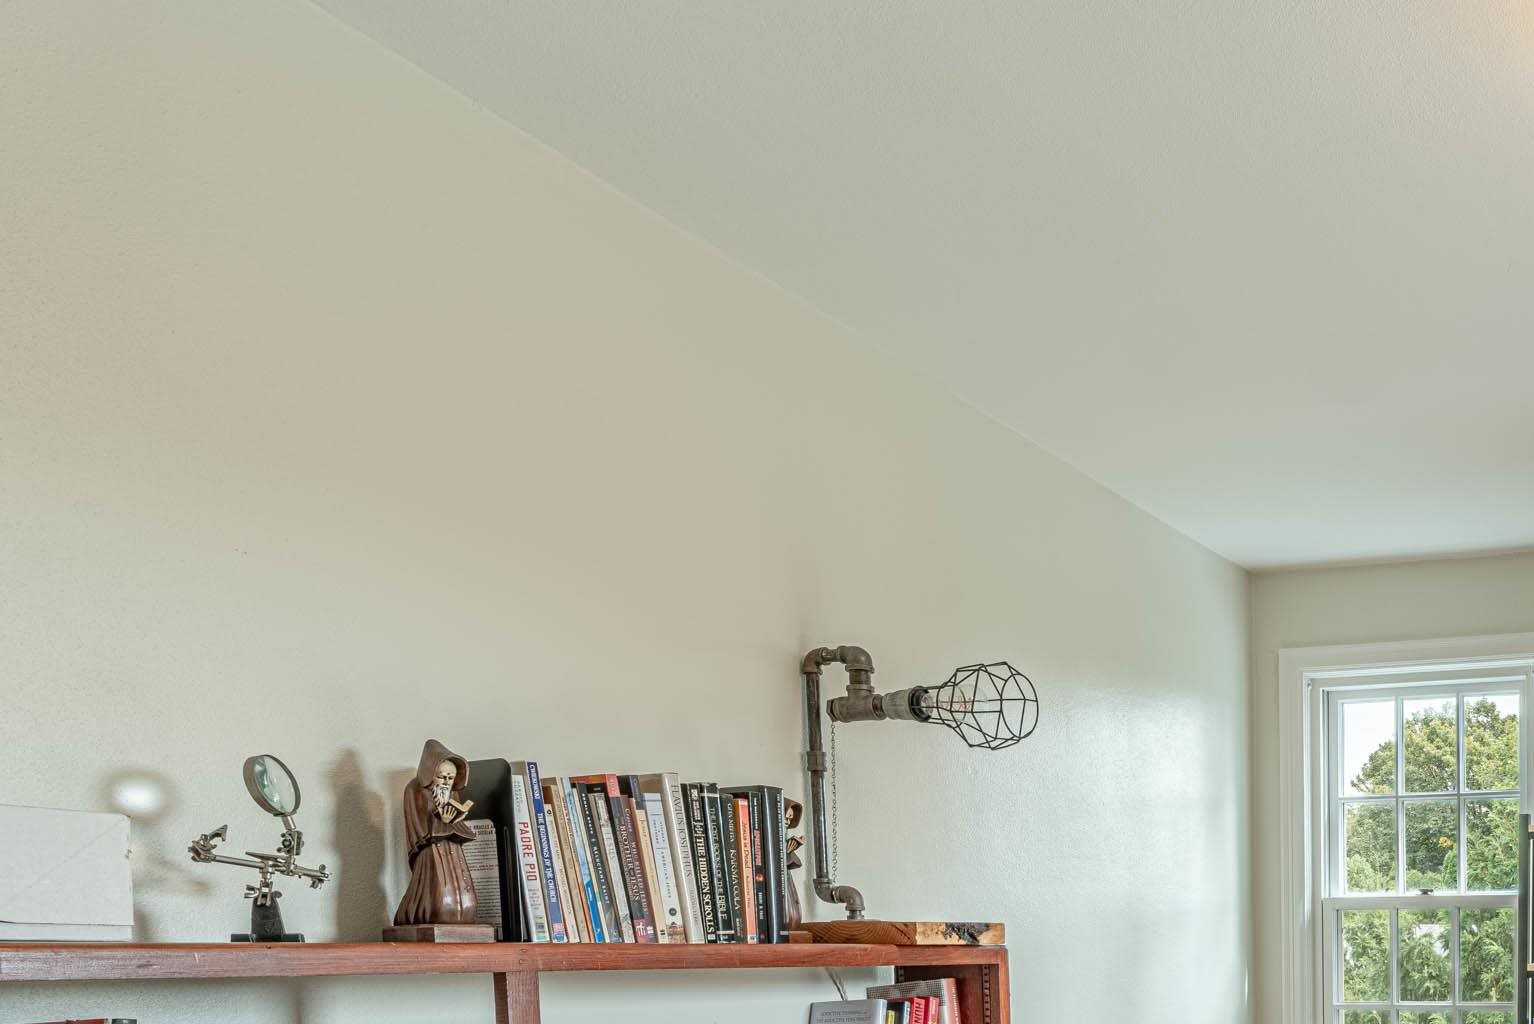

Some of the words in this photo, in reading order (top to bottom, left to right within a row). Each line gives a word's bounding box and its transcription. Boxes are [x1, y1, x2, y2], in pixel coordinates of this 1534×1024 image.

[536, 812, 545, 824] THE
[709, 808, 717, 821] THE
[518, 821, 534, 858] PADRE
[538, 824, 550, 858] BEGINNINGS
[671, 784, 685, 825] FLAVIUS
[678, 827, 692, 878] JOSEPHUS
[711, 822, 719, 841] LOST
[695, 837, 706, 856] THE
[712, 843, 722, 868] BOOKS
[524, 862, 538, 882] PIO
[543, 858, 552, 866] OF
[545, 868, 554, 878] THE
[619, 825, 634, 869] BROTHER
[629, 875, 640, 901] JESUS
[729, 849, 739, 884] KARMA
[592, 846, 605, 883] RELUCTANT
[600, 883, 609, 904] SAINT
[697, 856, 710, 894] HIDDEN
[547, 878, 558, 903] CHURCH
[732, 885, 740, 910] COLA
[702, 893, 715, 933] SCROLLS
[717, 894, 728, 921] BIBLE
